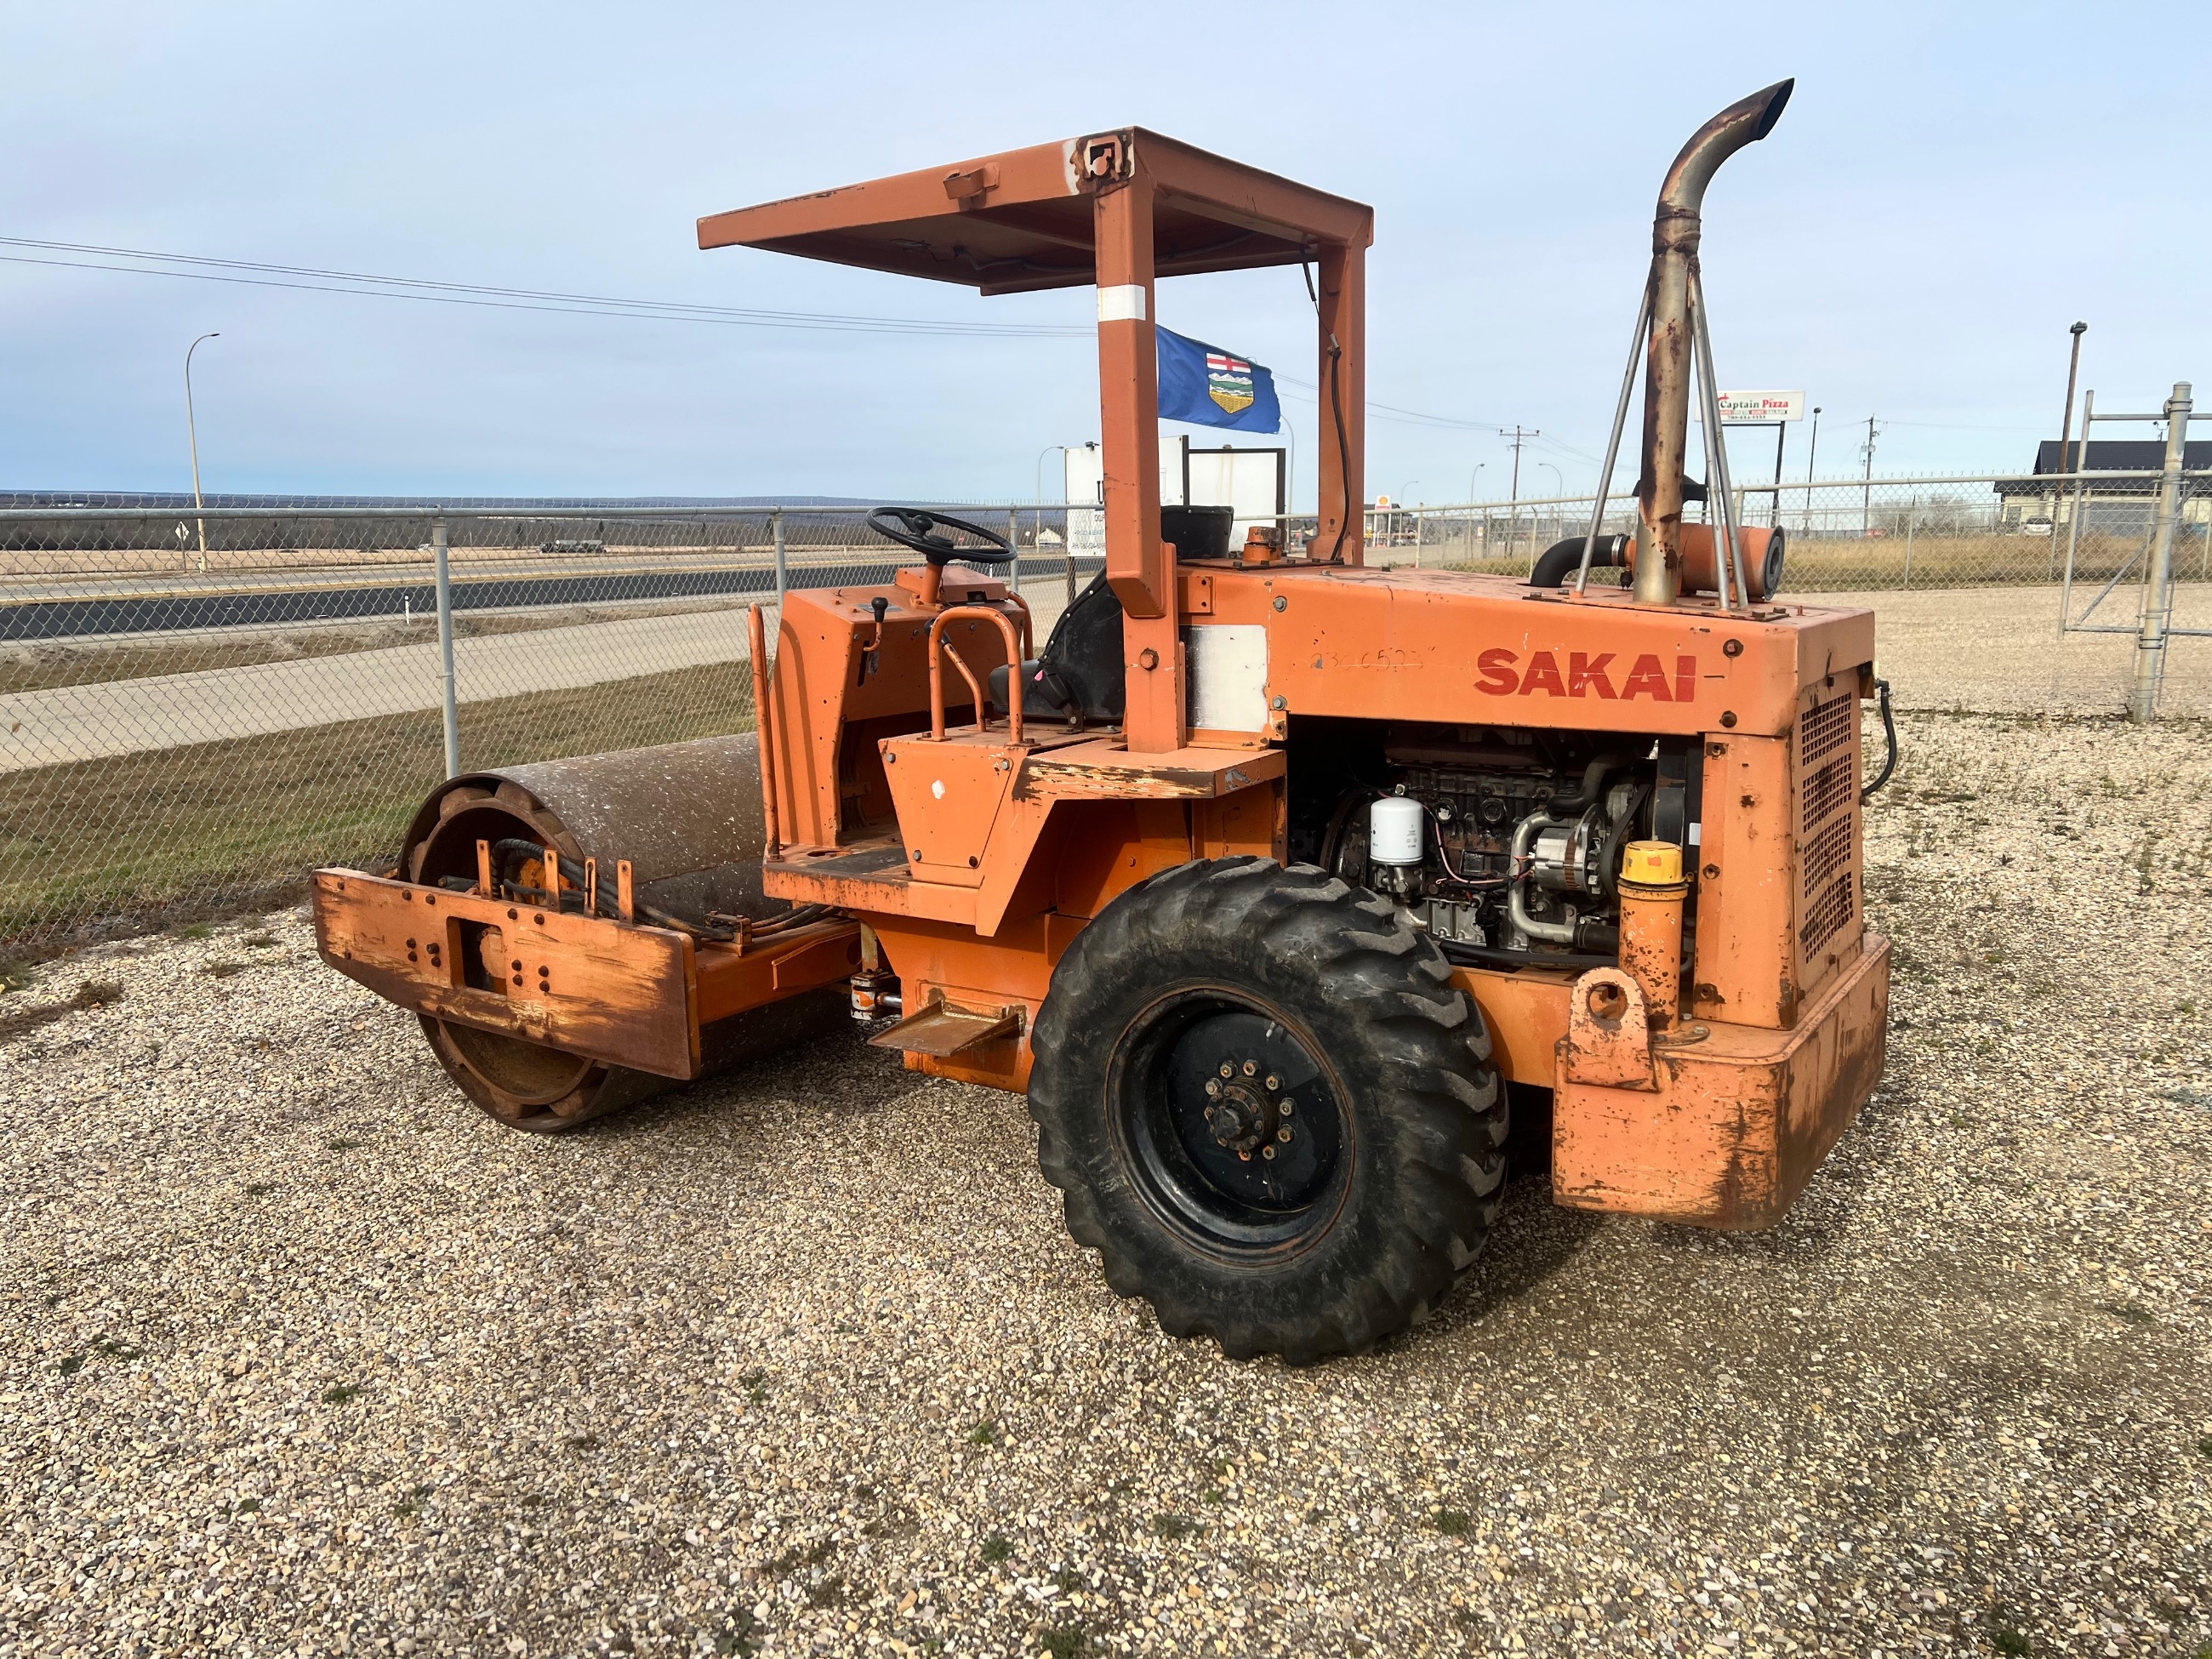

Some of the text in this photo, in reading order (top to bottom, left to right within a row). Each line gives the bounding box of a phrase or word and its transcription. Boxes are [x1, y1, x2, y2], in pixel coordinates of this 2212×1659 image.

[1720, 399, 1788, 409] Captain Pizza
[1473, 647, 1696, 703] SAKAI
